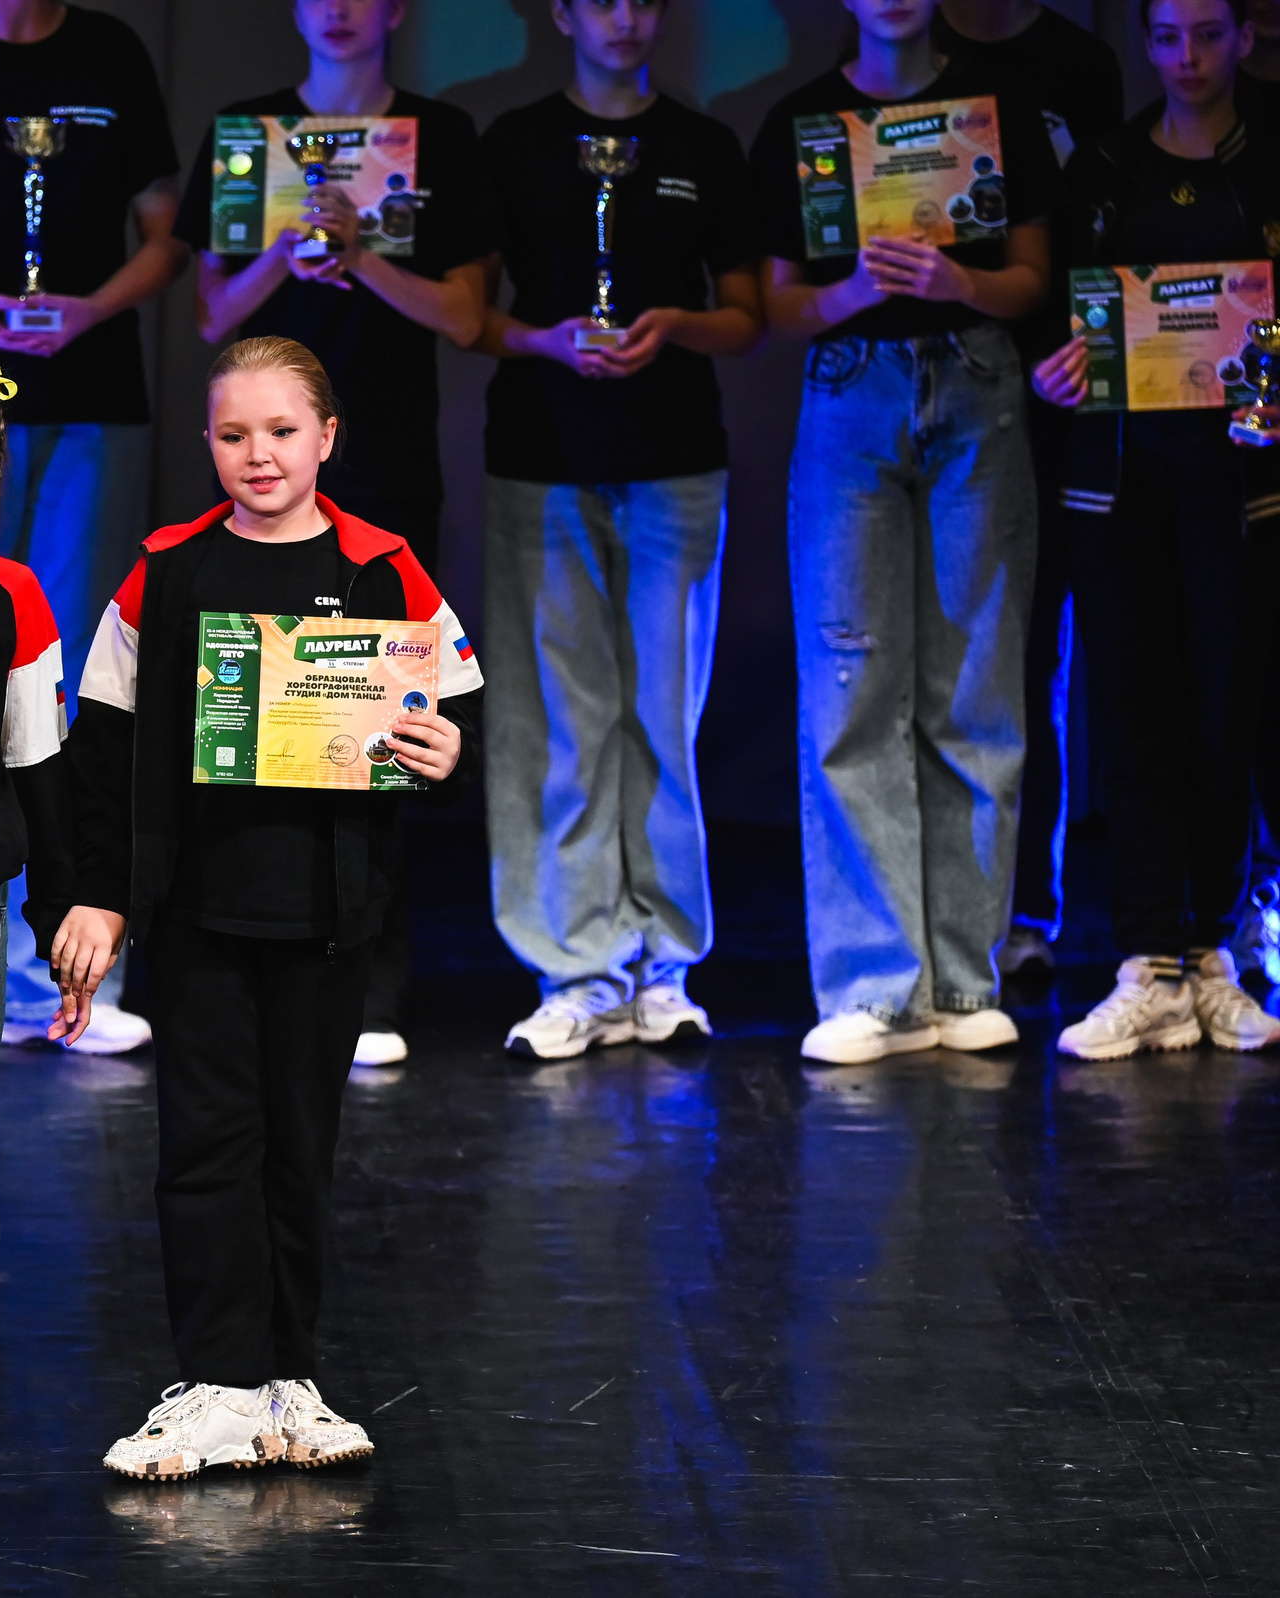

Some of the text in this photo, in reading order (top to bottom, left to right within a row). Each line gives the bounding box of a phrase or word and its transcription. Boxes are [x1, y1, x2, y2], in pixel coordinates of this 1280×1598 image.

[314, 596, 342, 606] СЕМ
[304, 639, 371, 653] ЛАУРЕАТ
[218, 650, 245, 658] ЛЕТО
[305, 674, 367, 684] ОБРАЗЦОВАЯ
[286, 681, 385, 692] ХОРЕОГРАФИЧЕСКАЯ
[284, 689, 386, 701] СТУДИЯ «ДОМ ТАНЦА»
